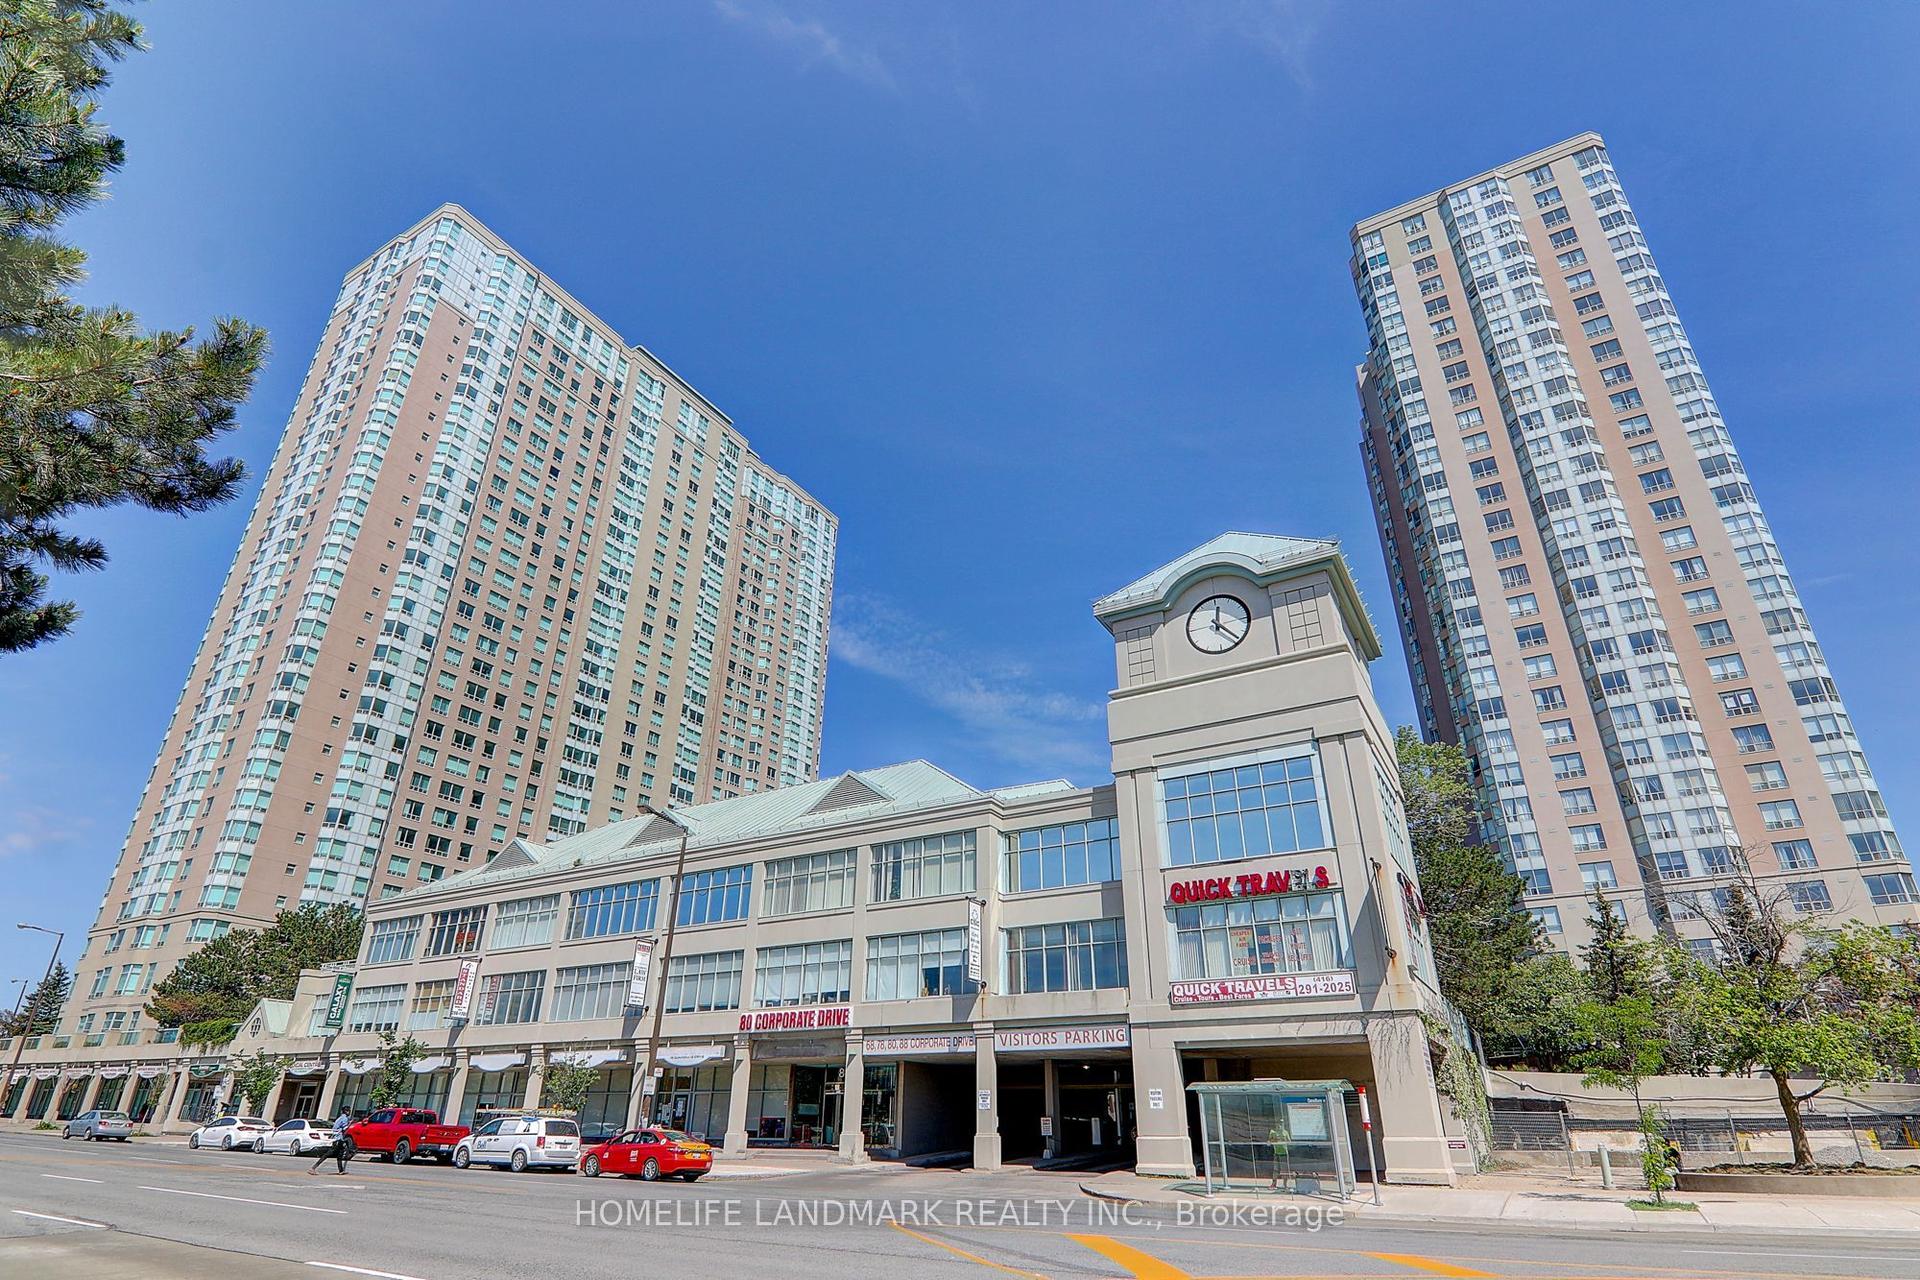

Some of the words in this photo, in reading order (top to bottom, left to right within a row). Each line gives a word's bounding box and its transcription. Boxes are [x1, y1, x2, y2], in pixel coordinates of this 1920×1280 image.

[1170, 877, 1233, 905] QUICK
[1173, 982, 1221, 997] QUICK
[1224, 977, 1296, 995] TRAVELS
[1298, 981, 1352, 995] 291-2025
[1313, 975, 1334, 983] (416)
[330, 984, 347, 1019] GALAXY
[740, 1014, 752, 1031] 80
[755, 1010, 815, 1030] CORPORATE
[818, 1008, 850, 1027] DRIVE
[911, 1037, 951, 1048] CORPORATE
[953, 1035, 974, 1047] DRIVE
[1000, 1031, 1058, 1046] VISITORS
[1065, 1028, 1125, 1044] PARKING
